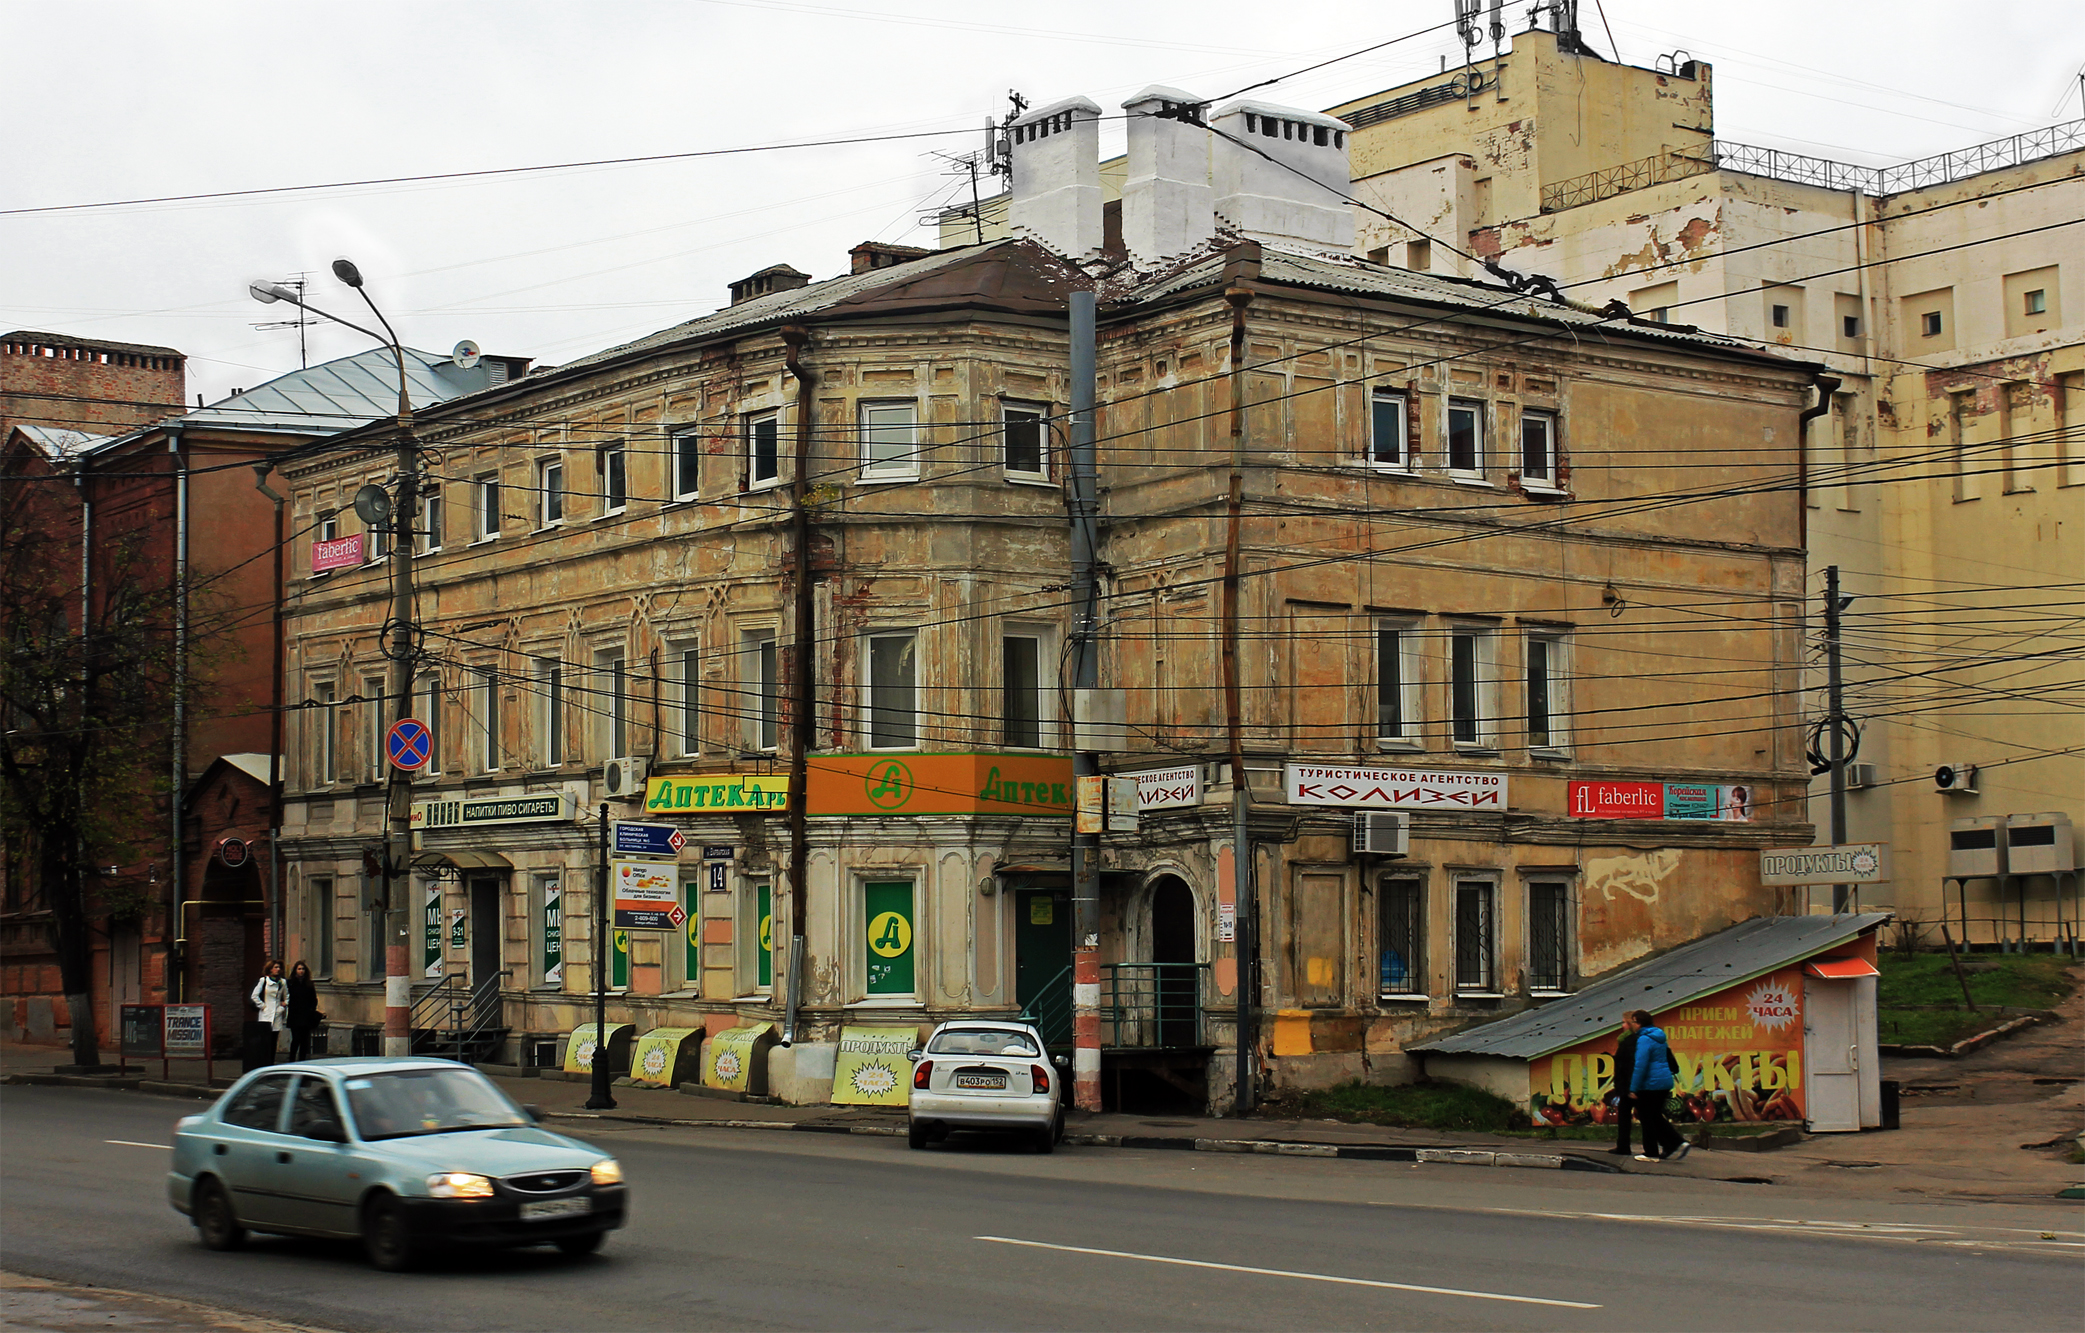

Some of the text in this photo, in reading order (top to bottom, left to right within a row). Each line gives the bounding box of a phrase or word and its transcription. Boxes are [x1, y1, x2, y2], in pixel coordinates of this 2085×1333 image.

[318, 538, 359, 560] faberlic
[1158, 770, 1195, 782] АГЕНТСТВО
[1299, 768, 1499, 786] ТУРИСТИЧЕСКОЕ АГЕНТСТВО
[1138, 784, 1195, 805] ЛИЗЕЙ
[1298, 783, 1499, 806] КОЛИЗЕЙ
[1598, 786, 1657, 806] faberlic
[465, 801, 556, 819] НАПИТКИ ПИВО СИГАРЕТЫ
[1762, 852, 1852, 876] ПРОДУКТЫ
[713, 866, 723, 888] 14
[1763, 993, 1784, 1004] 24
[1680, 1007, 1738, 1021] ПРИЕМ
[1752, 1006, 1793, 1017] ЧАСА
[166, 1016, 202, 1028] TRANCE
[166, 1028, 203, 1041] MISSION
[1663, 1023, 1754, 1040] ПЛАТЕЖЕЙ
[840, 1039, 918, 1056] ПРОДУКТЫ
[718, 1065, 737, 1074] ЧАСА
[1551, 1051, 1800, 1095] ПРУКТЫ
[960, 1077, 991, 1086] В403РО
